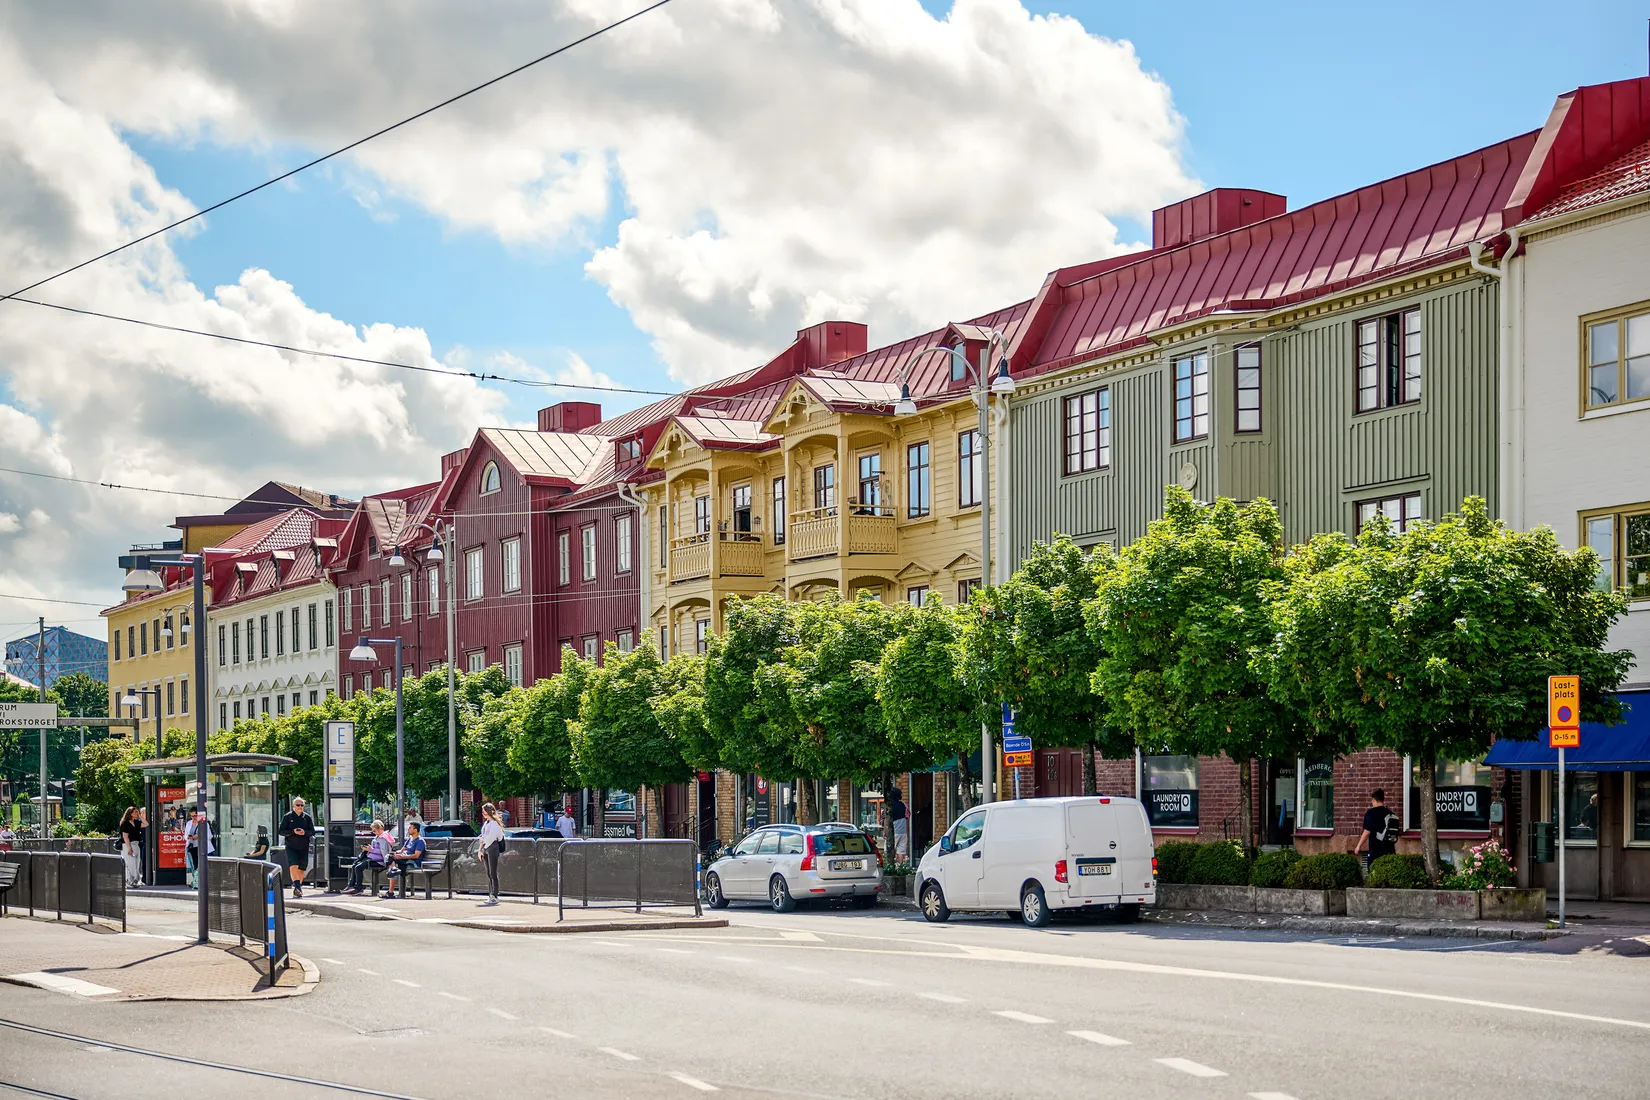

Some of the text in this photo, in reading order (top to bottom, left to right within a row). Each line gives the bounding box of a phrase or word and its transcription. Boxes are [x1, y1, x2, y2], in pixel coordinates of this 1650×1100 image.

[1554, 691, 1575, 700] plats
[337, 727, 346, 745] E
[1304, 763, 1333, 774] REDBERG
[1153, 794, 1180, 802] LAUNDRY
[1435, 792, 1463, 801] UNDRY
[1160, 803, 1180, 812] ROOM
[1435, 802, 1462, 812] ROOM
